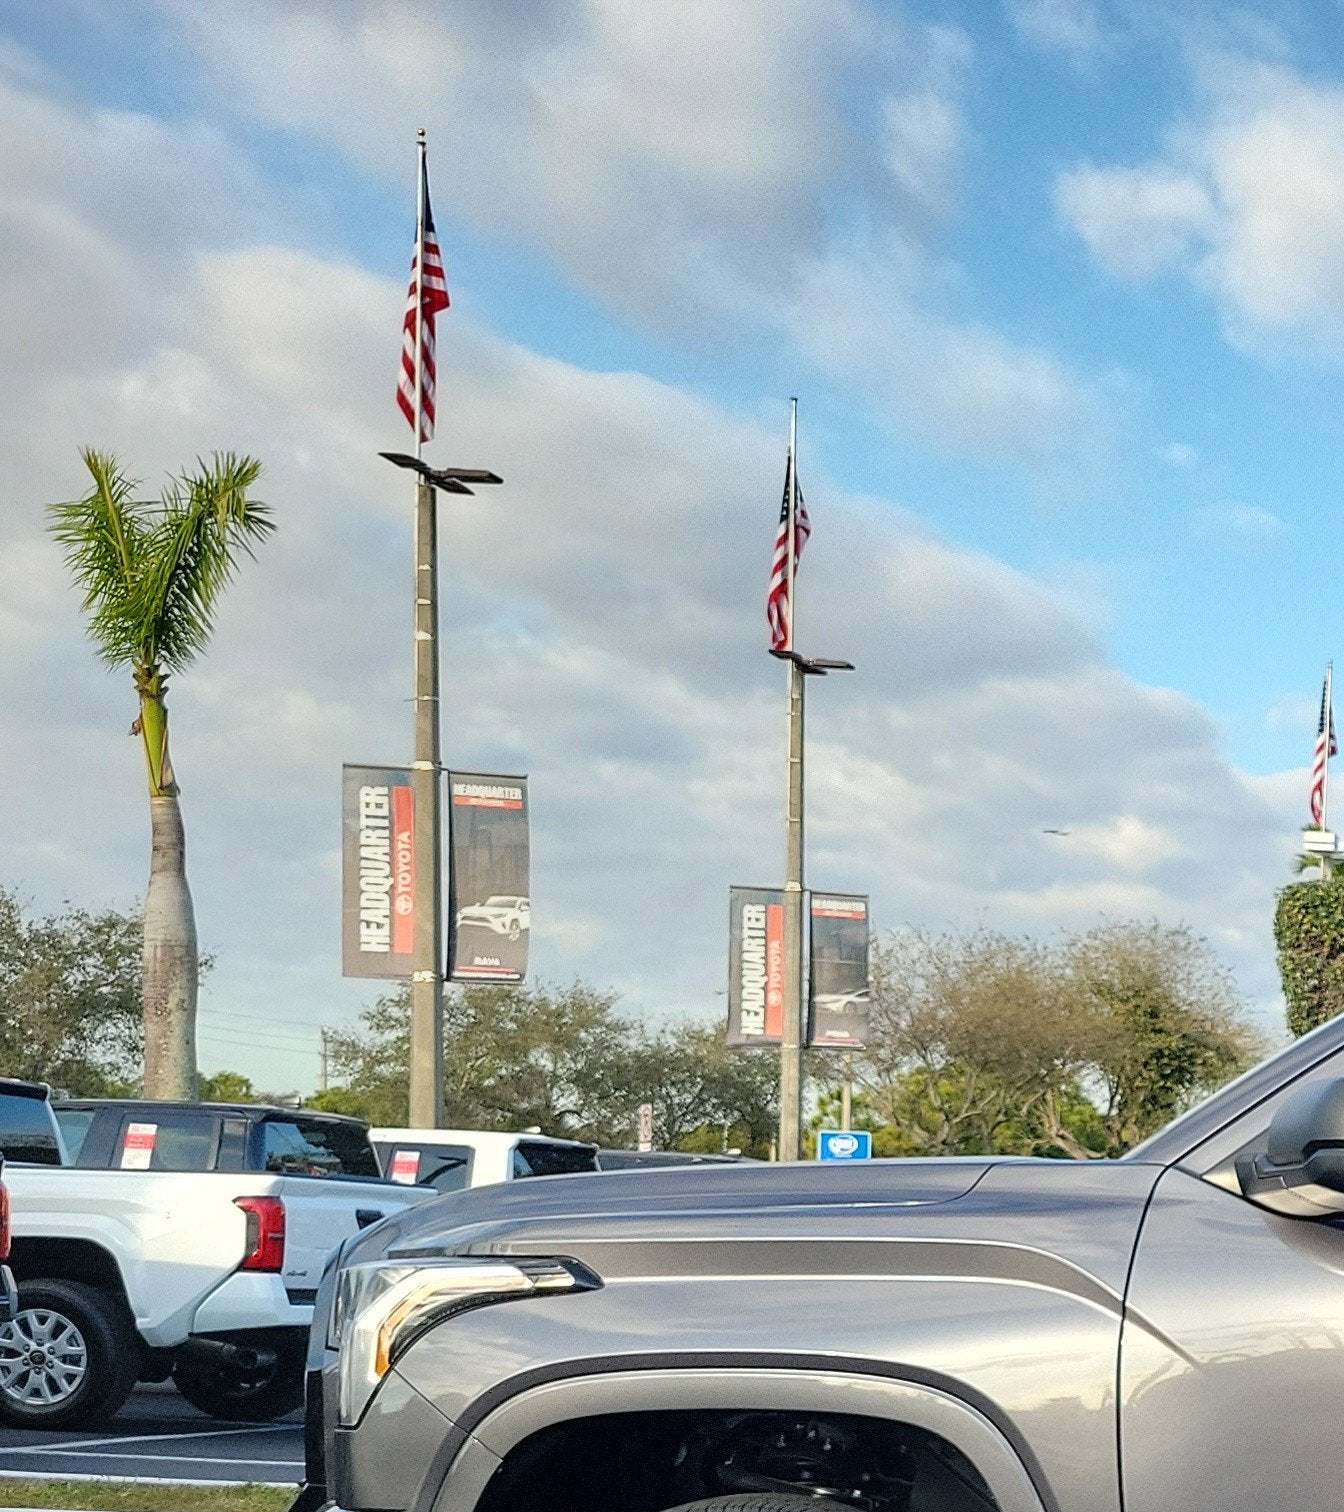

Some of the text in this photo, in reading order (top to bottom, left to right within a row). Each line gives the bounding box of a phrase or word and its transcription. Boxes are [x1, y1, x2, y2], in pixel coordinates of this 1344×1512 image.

[360, 786, 394, 953] HEADQUARTER
[397, 831, 412, 893] TOYOTA
[741, 904, 767, 1034] HEADQUARTER
